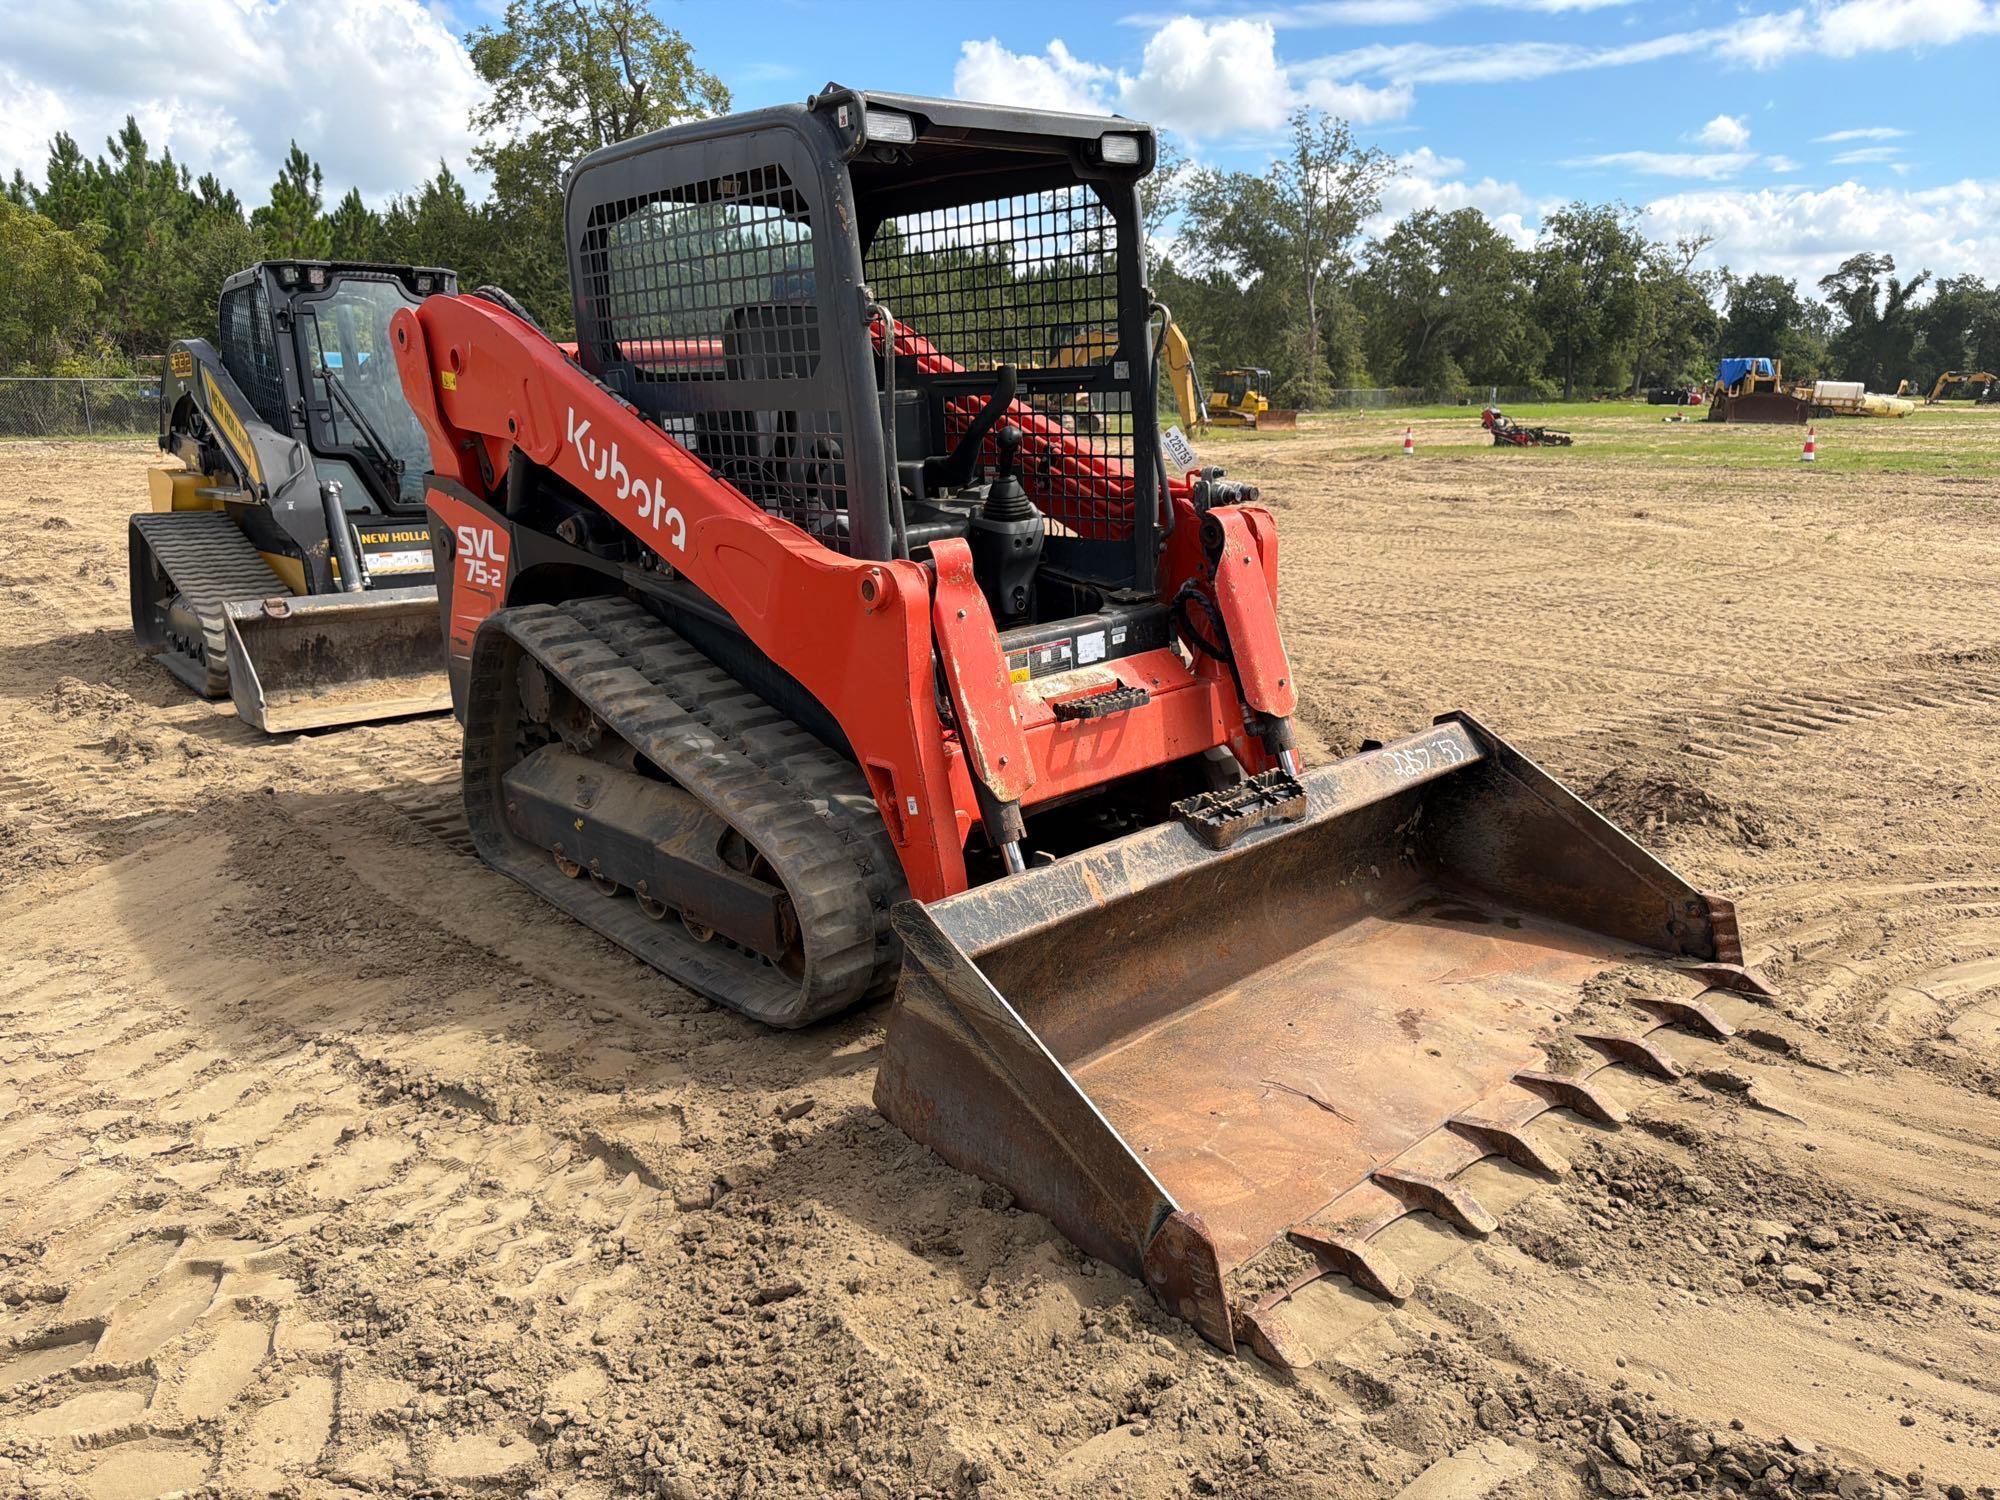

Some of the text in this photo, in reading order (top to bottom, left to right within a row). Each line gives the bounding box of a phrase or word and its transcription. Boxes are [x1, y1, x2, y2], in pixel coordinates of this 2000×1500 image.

[1169, 435, 1193, 465] 225753
[567, 406, 687, 552] Kubota
[361, 531, 430, 544] NEW HOLLA
[457, 526, 505, 562] SVL
[464, 558, 502, 588] 75-2
